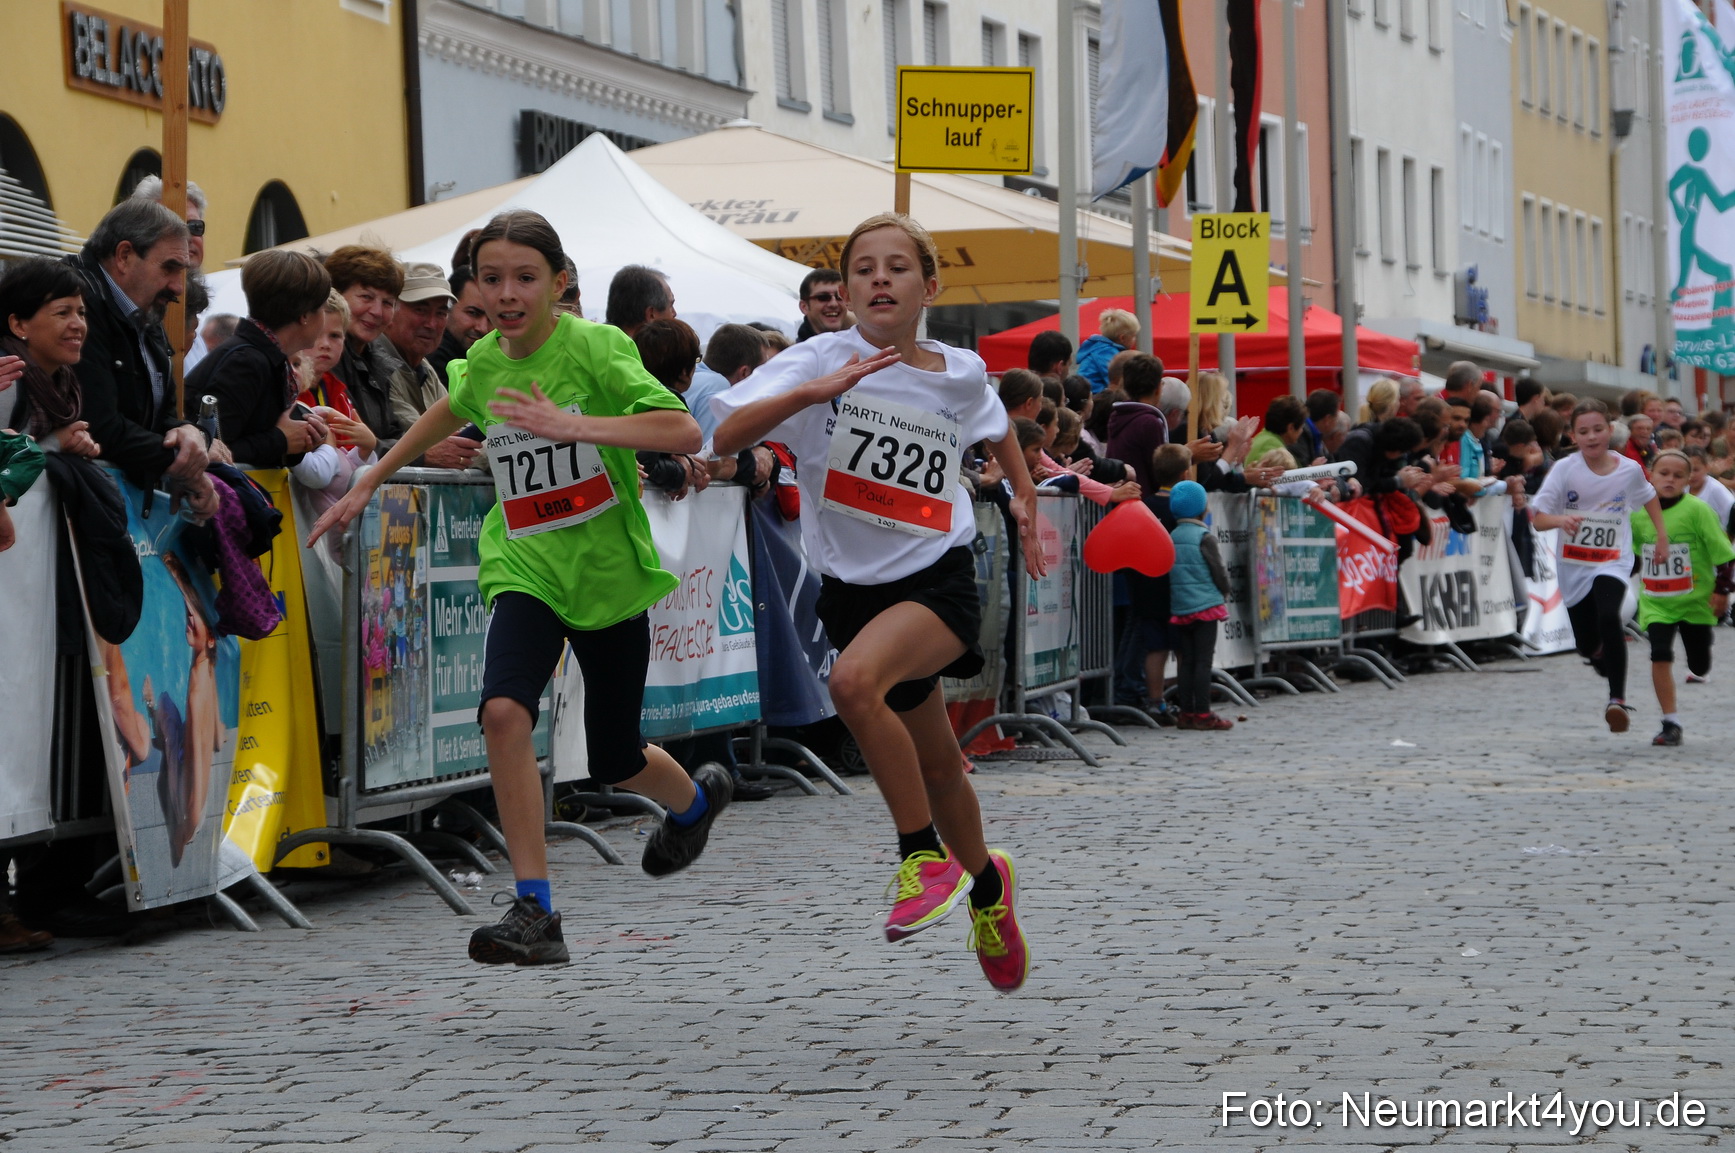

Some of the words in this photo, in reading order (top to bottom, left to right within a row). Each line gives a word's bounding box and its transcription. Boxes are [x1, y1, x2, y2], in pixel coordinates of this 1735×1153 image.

[72, 10, 226, 115] BELACCNTO
[906, 96, 1023, 123] Schnupper-
[945, 126, 983, 147] lauf
[1201, 217, 1260, 239] Block
[1206, 249, 1251, 306] A
[842, 402, 886, 425] PARTL
[889, 415, 947, 443] Neumarkt
[497, 440, 581, 495] 7277
[847, 427, 947, 494] 7328
[534, 496, 573, 518] Lena
[855, 481, 894, 507] Paula
[435, 594, 462, 637] Mehr
[436, 655, 452, 697] für
[454, 652, 468, 694] Ihr
[437, 738, 452, 764] Miet
[452, 738, 458, 760] &
[459, 732, 480, 760] Service
